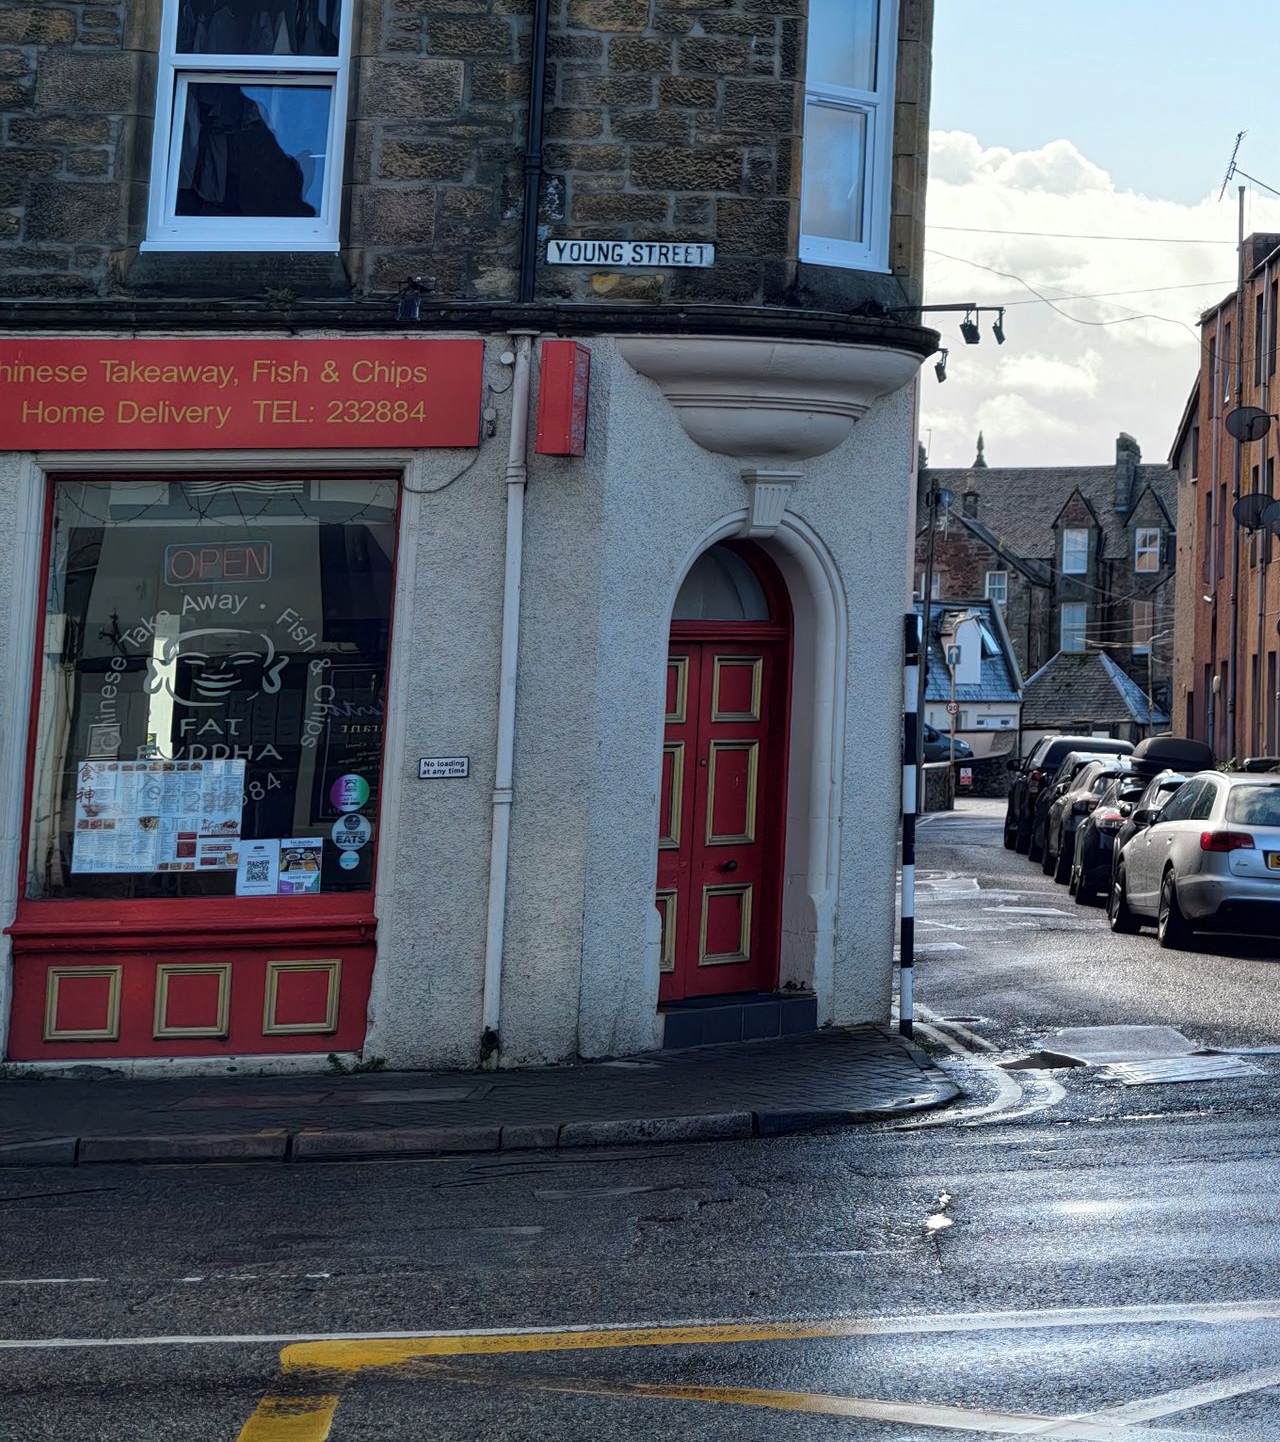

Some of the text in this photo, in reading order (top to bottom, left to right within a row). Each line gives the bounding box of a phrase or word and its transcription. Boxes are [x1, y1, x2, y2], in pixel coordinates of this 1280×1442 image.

[555, 242, 708, 264] YOUNG STREET
[99, 360, 239, 388] Takeaway,
[252, 360, 309, 383] Fish
[320, 360, 340, 383] &
[352, 360, 428, 388] Chips
[22, 400, 427, 429] Home Delivery TEL: 232884
[170, 546, 267, 579] OPEN
[96, 594, 336, 751] Chinese Take Away Fish & Chips
[180, 718, 243, 738] FAT
[136, 743, 283, 760] BUDDHA
[335, 836, 366, 844] EATS
